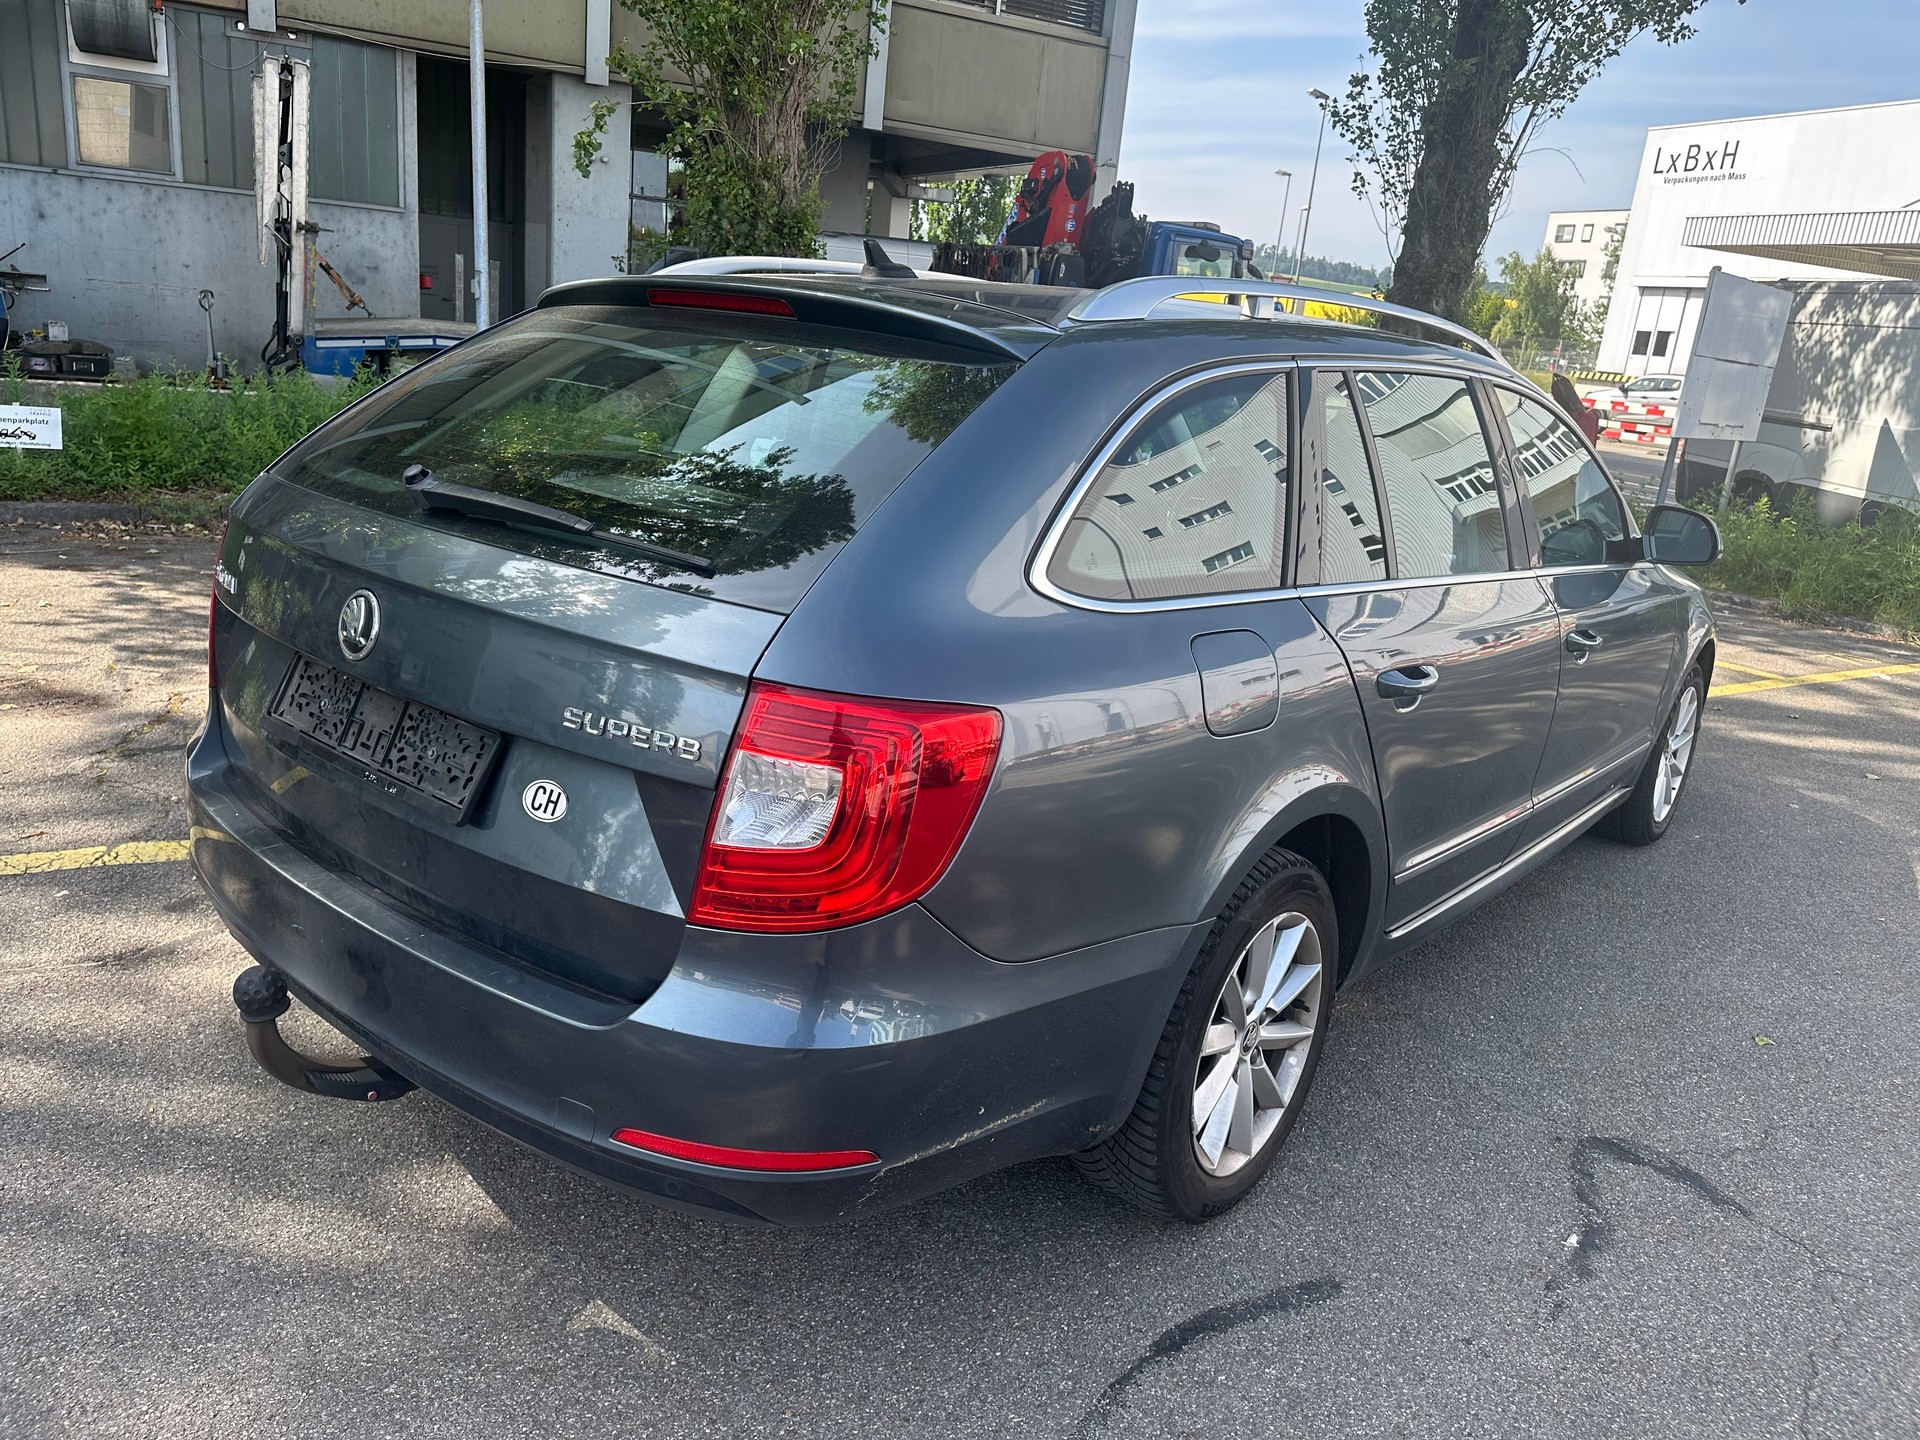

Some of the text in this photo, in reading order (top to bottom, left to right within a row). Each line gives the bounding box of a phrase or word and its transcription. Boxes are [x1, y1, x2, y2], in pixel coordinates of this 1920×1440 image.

[1653, 140, 1740, 175] LxBxH
[1663, 172, 1747, 186] Verpackungen nach Mass
[562, 706, 702, 762] SUPERB
[530, 785, 562, 817] CH
